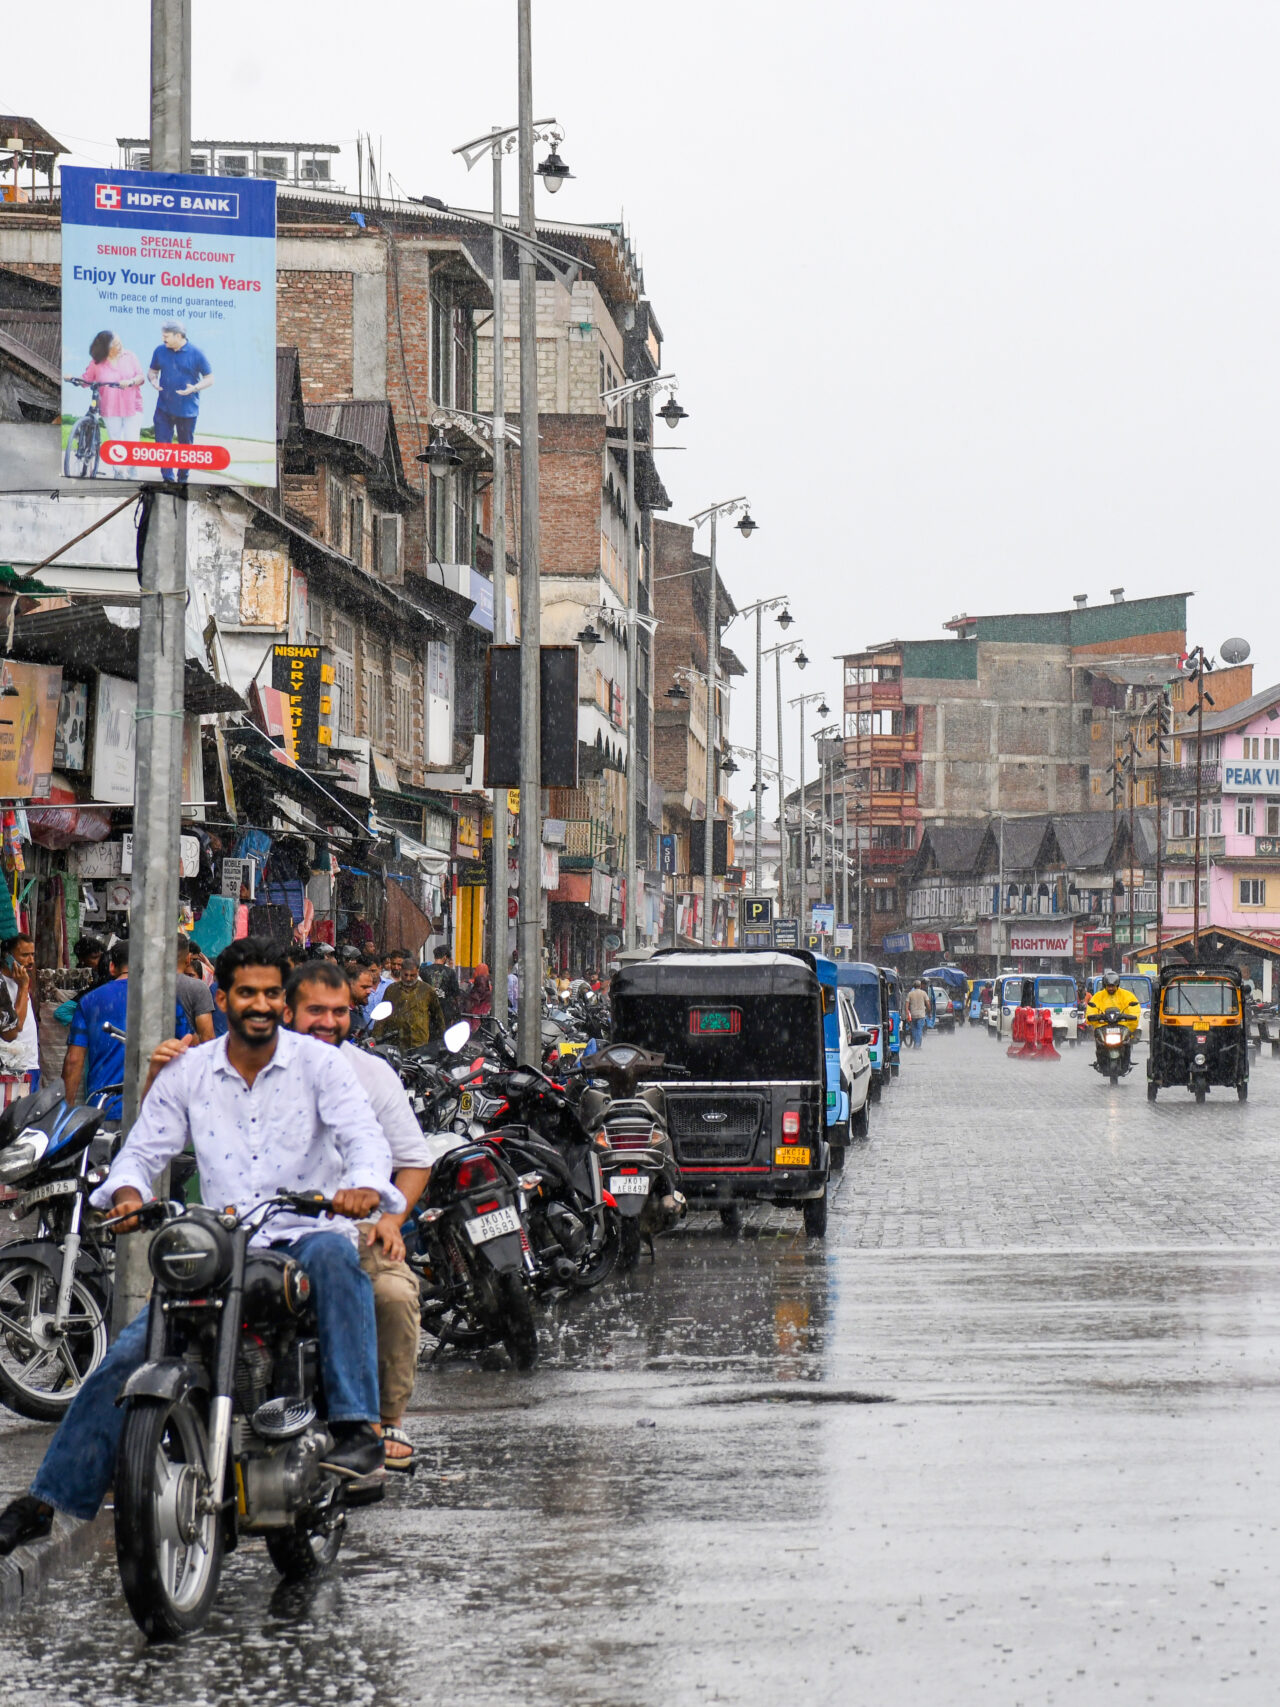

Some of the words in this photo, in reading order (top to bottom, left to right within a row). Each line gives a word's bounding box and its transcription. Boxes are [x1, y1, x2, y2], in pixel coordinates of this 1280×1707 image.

[127, 192, 175, 207] HDFC
[180, 196, 230, 212] BANK
[140, 236, 192, 249] SPECIALÉ
[97, 244, 137, 257] SENIOR
[140, 248, 182, 260] CITIZEN
[185, 250, 235, 263] ACCOUNT
[73, 265, 117, 285] Enjoy
[121, 269, 156, 285] Your
[160, 271, 214, 289] Golden
[219, 275, 262, 292] Years
[98, 290, 118, 301] With
[121, 293, 147, 304] peace
[149, 294, 159, 303] of
[161, 295, 183, 305] mind
[109, 304, 134, 315] make
[136, 306, 150, 315] the
[153, 307, 174, 317] most
[176, 308, 186, 317] of
[188, 310, 207, 319] your
[132, 447, 213, 464] 9906715858
[274, 646, 320, 658] NISHAT
[290, 660, 305, 691] DRY
[1225, 767, 1262, 785] PEAK
[752, 903, 763, 918] P
[809, 936, 818, 948] P
[1011, 938, 1069, 950] RIGHTWAY
[834, 947, 842, 957] P
[624, 1177, 642, 1185] JK01
[481, 1210, 511, 1229] JK01A
[483, 1219, 515, 1239] P9583
